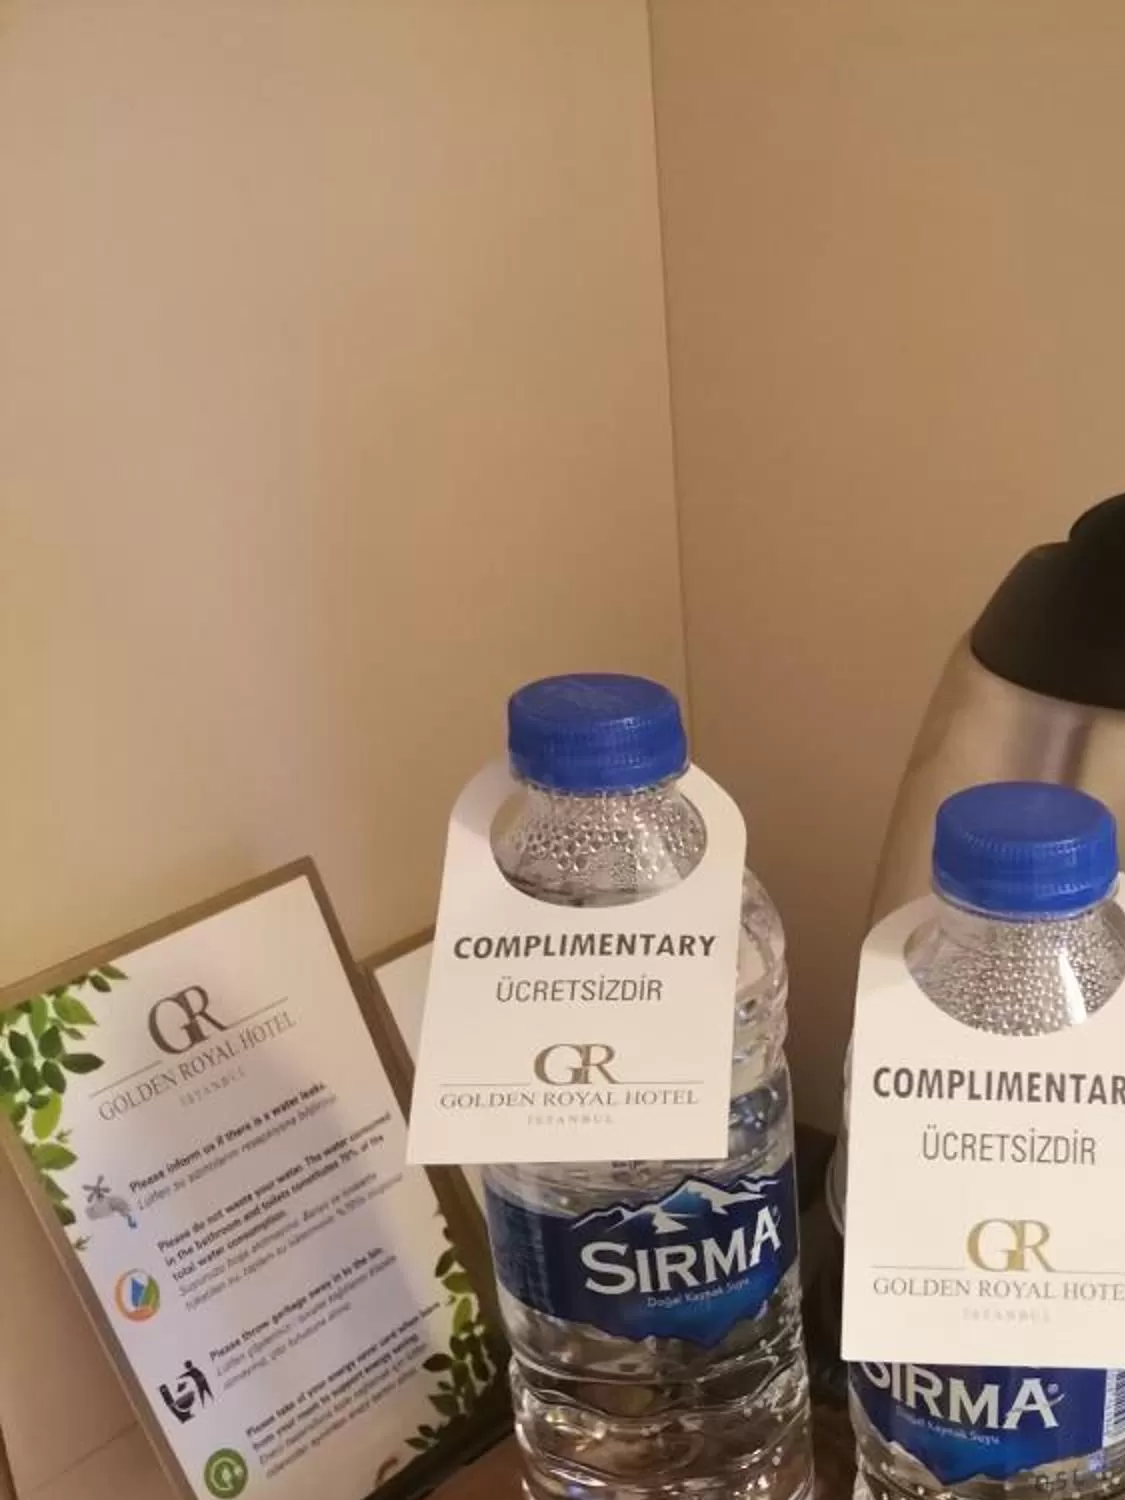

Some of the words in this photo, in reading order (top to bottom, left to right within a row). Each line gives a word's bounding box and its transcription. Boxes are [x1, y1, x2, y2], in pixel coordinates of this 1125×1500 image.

[453, 933, 717, 960] COMPLIMENTARY
[496, 973, 663, 1002] ÜCRETSİZDİR
[148, 985, 226, 1055] GR
[98, 1068, 177, 1123] GOLDEN
[179, 1036, 239, 1082] ROYAL
[239, 1007, 296, 1051] HOTEL
[533, 1043, 622, 1086] GR
[439, 1091, 536, 1109] GOLDEN
[543, 1090, 618, 1107] ROYAL
[625, 1089, 699, 1105] HOTEL
[922, 1124, 1097, 1165] ÜCRETSİZDİR
[580, 1205, 781, 1295] SIRMA
[967, 1218, 1056, 1273] GR
[872, 1277, 971, 1297] GOLDEN
[978, 1280, 1060, 1299] ROYAL
